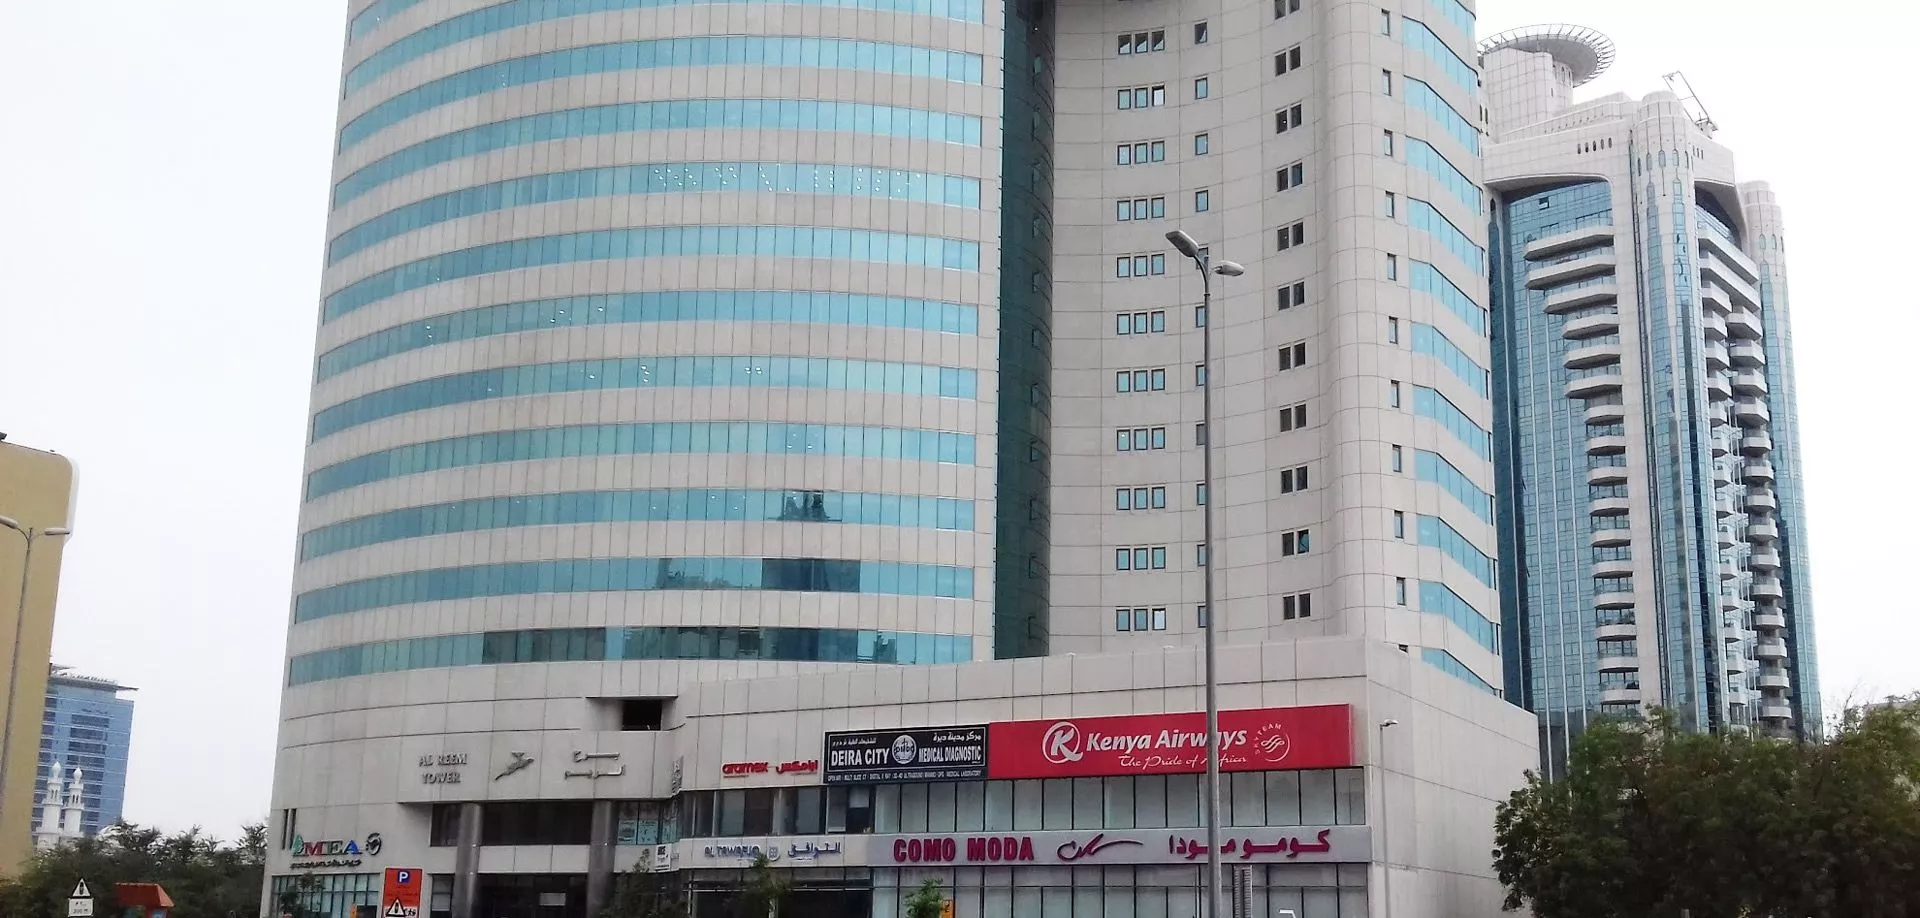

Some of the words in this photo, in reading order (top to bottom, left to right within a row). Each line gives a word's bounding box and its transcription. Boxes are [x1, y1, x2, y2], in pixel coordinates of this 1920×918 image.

[933, 732, 947, 743] ديرة
[947, 731, 965, 742] مدينة
[965, 730, 982, 741] مركز
[1086, 732, 1152, 754] Kenya
[1154, 729, 1247, 750] Airwys
[438, 752, 468, 766] REEM
[831, 749, 862, 767] DEIRA
[864, 747, 890, 765] CITY
[918, 746, 944, 763] MEDICAL
[944, 744, 982, 762] DIAGNOSTIC
[722, 762, 768, 774] aramex
[1118, 755, 1142, 767] The
[1143, 755, 1183, 770] Pride
[1186, 754, 1199, 768] of
[423, 772, 461, 784] TOWER
[303, 839, 363, 856] MEA
[787, 842, 840, 858] التوافق
[893, 838, 956, 862] COMO
[967, 836, 1034, 861] MODA
[1240, 828, 1331, 860] كومو
[399, 871, 408, 882] P
